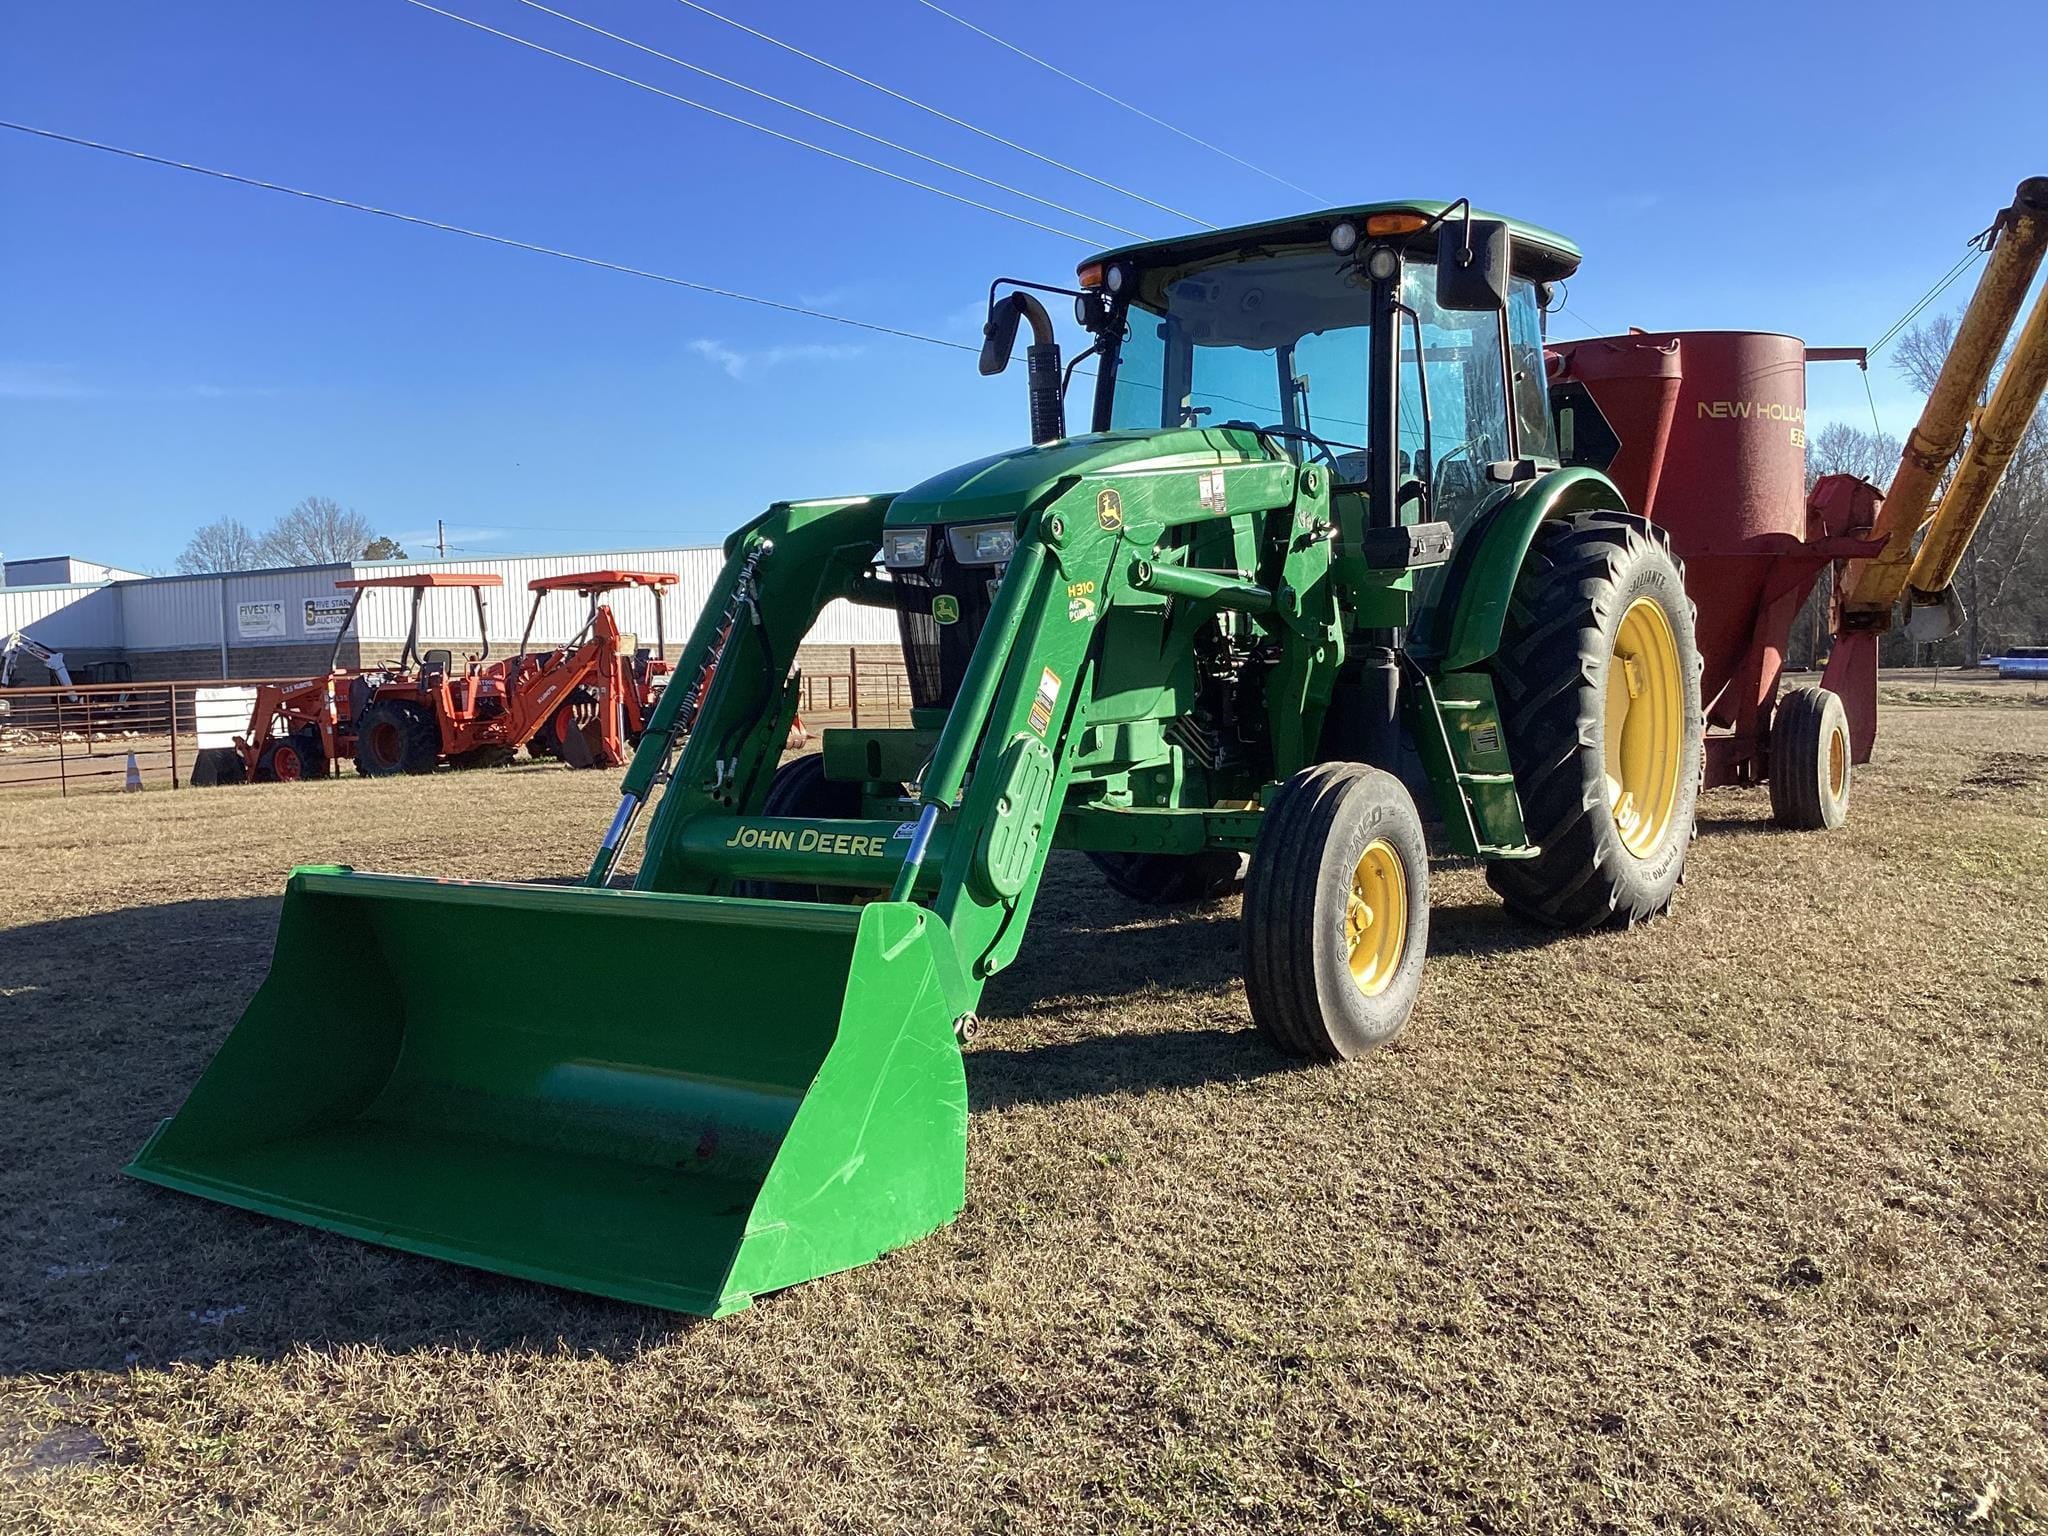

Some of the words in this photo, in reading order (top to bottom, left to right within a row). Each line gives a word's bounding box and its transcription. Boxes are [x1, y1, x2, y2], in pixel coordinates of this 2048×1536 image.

[1698, 401, 1751, 419] NEW
[1067, 581, 1095, 598] H310
[240, 603, 281, 616] FIVESTR
[316, 601, 330, 609] FIVE
[726, 825, 796, 850] JOHN
[798, 828, 887, 857] DEERE
